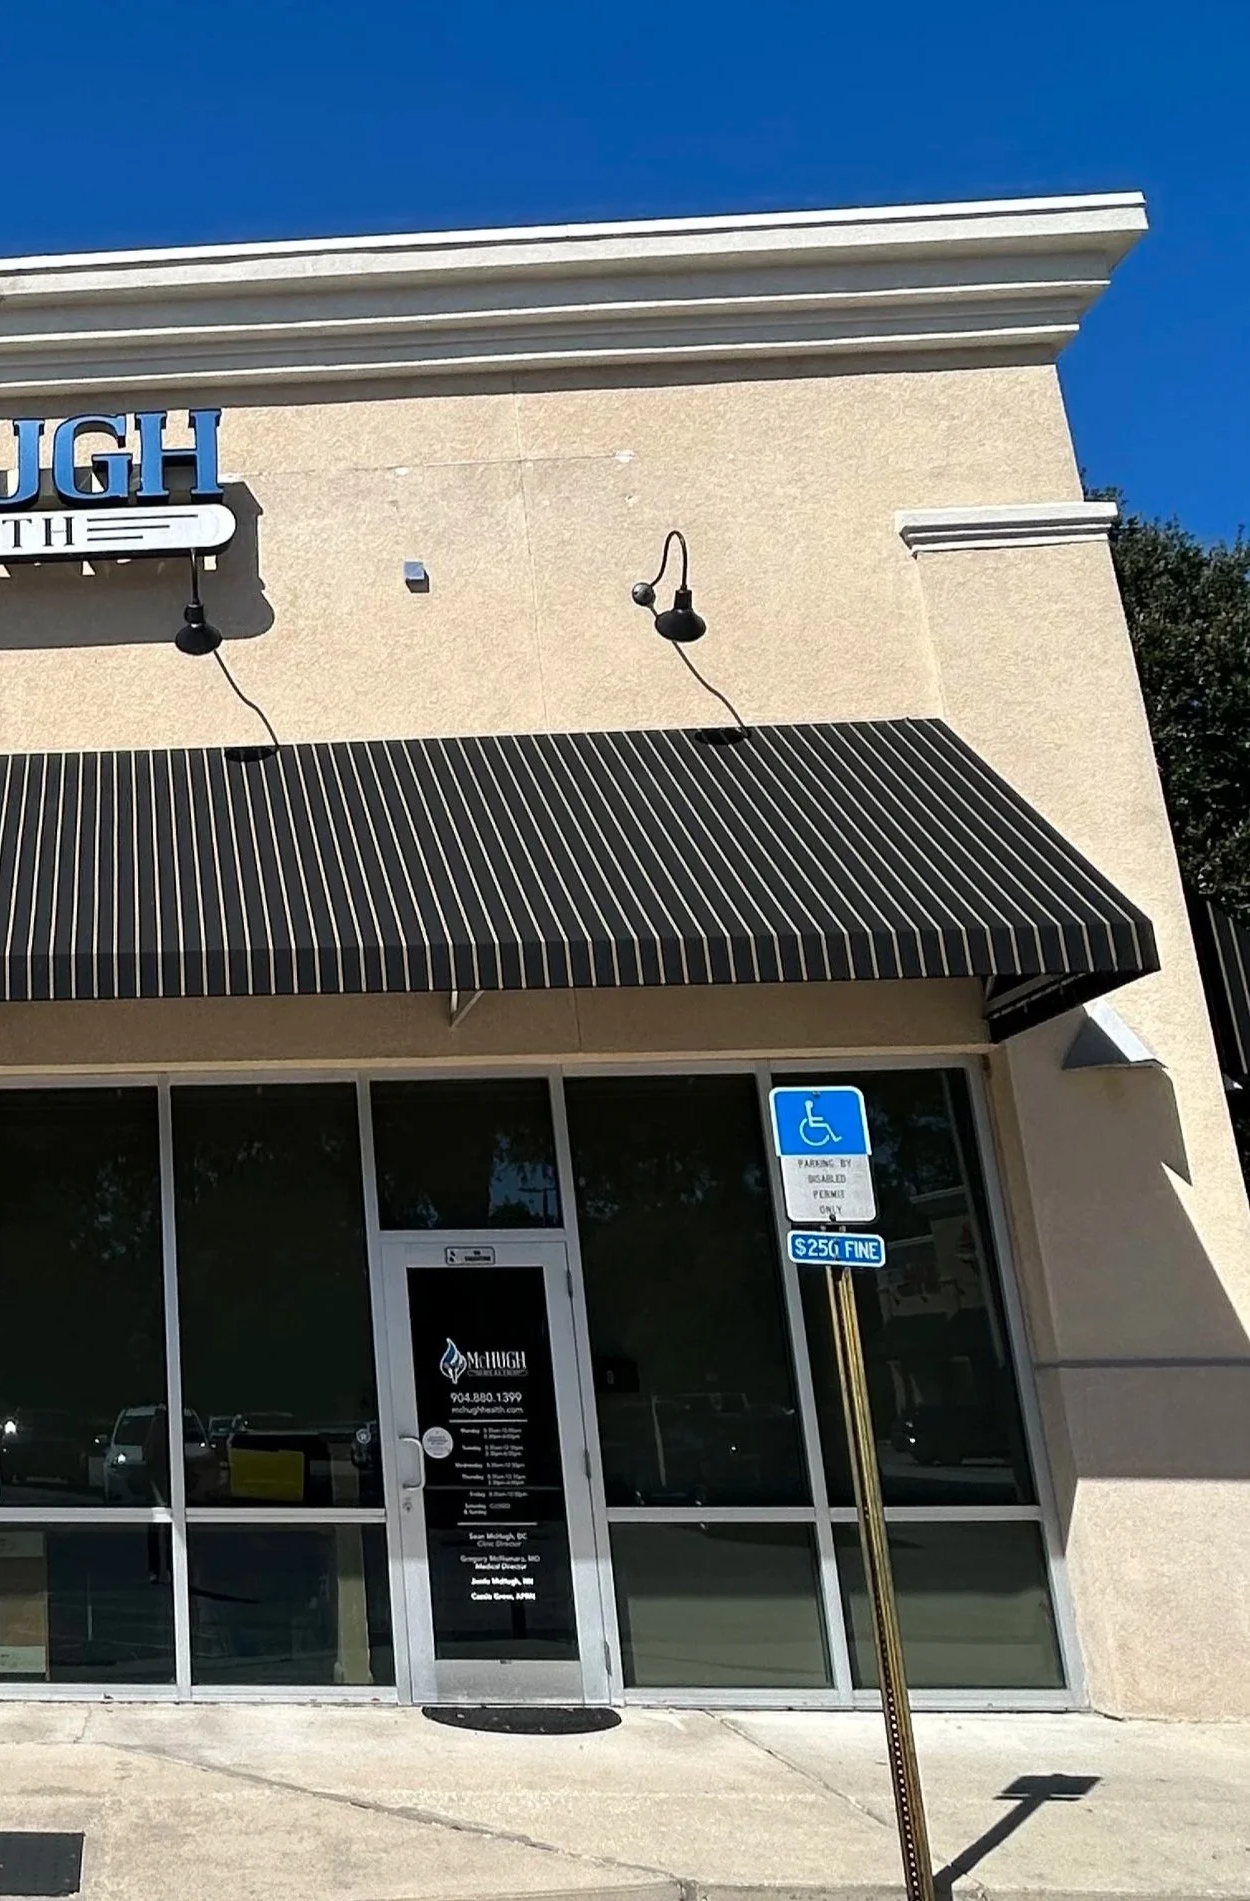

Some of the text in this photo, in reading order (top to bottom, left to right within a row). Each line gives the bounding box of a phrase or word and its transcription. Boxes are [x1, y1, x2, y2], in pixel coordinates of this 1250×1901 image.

[798, 1159, 852, 1169] PARKING BY
[808, 1174, 846, 1184] DISABLED
[813, 1190, 845, 1200] PERMIT
[819, 1205, 843, 1215] ONLY
[794, 1238, 880, 1260] $250 FINE
[466, 1350, 527, 1369] McHUGH
[450, 1391, 523, 1403] 904.880.1399
[501, 1562, 527, 1570] Director
